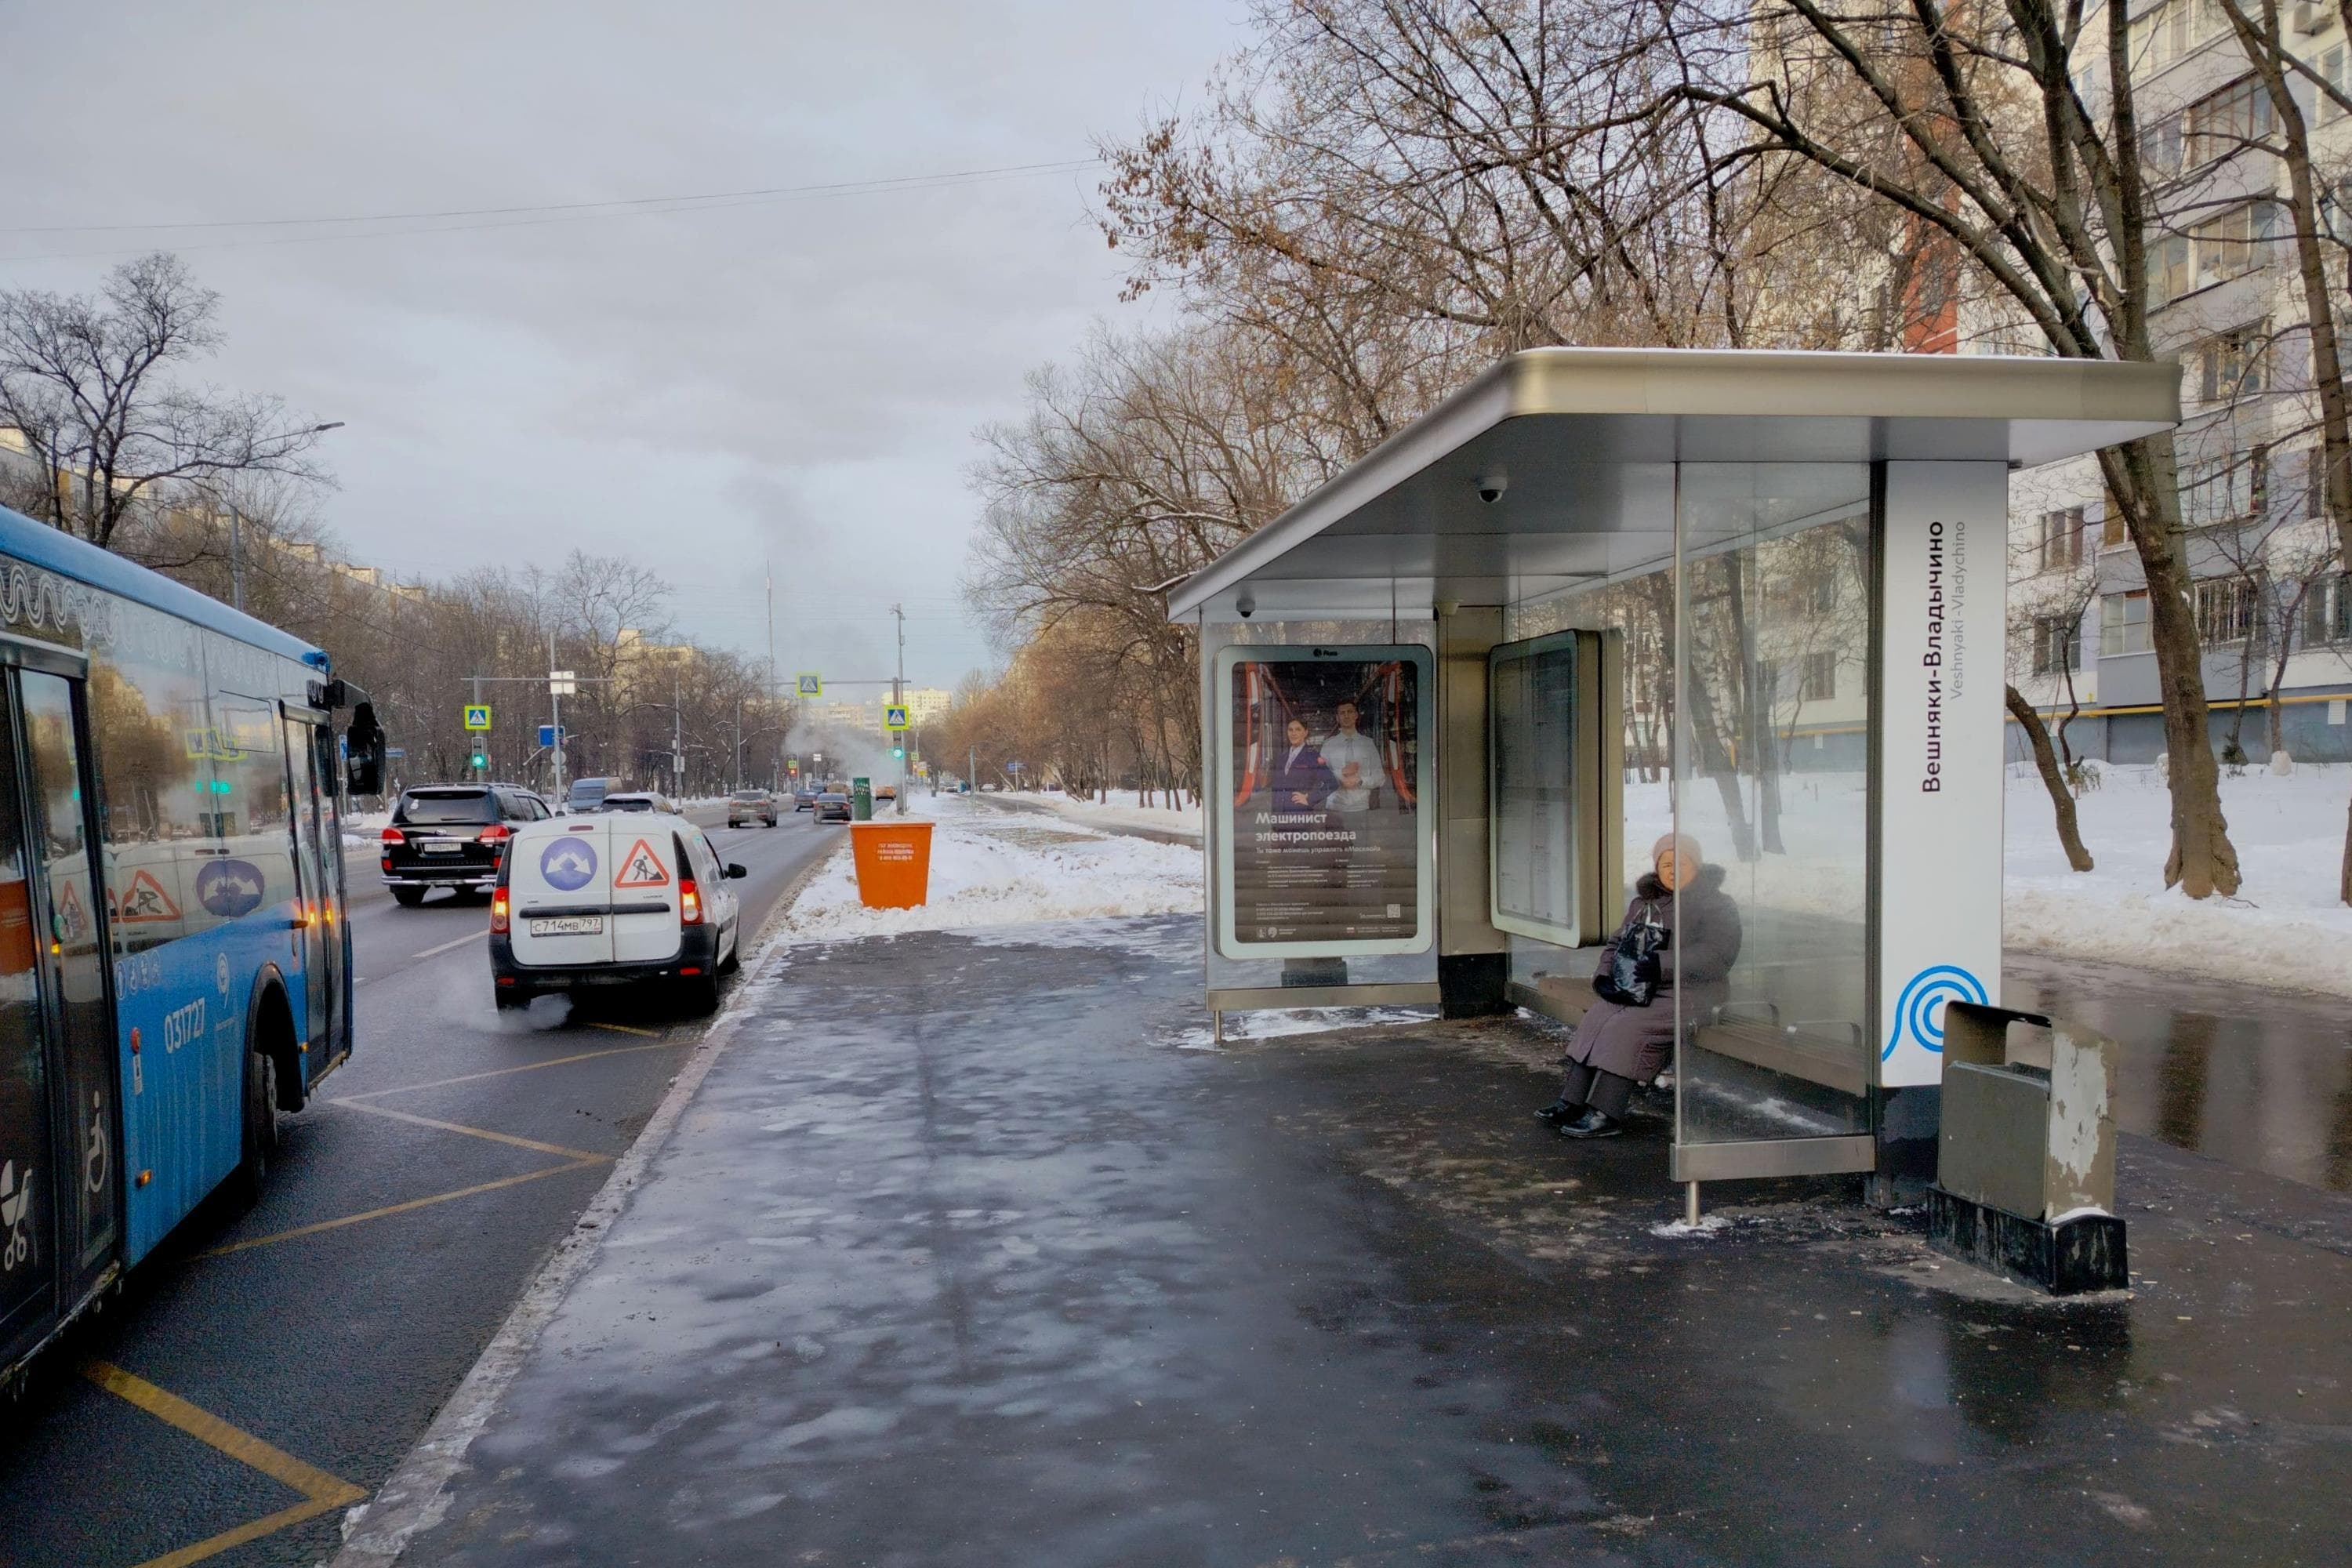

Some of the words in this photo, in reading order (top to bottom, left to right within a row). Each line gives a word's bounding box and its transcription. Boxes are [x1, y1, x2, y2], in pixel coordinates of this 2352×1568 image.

[1922, 521, 1944, 793] Вешняки-Владычино
[1256, 812, 1327, 824] Машинист
[1256, 831, 1356, 843] электропоезда
[581, 918, 599, 928] 797
[165, 997, 205, 1054] 031727
